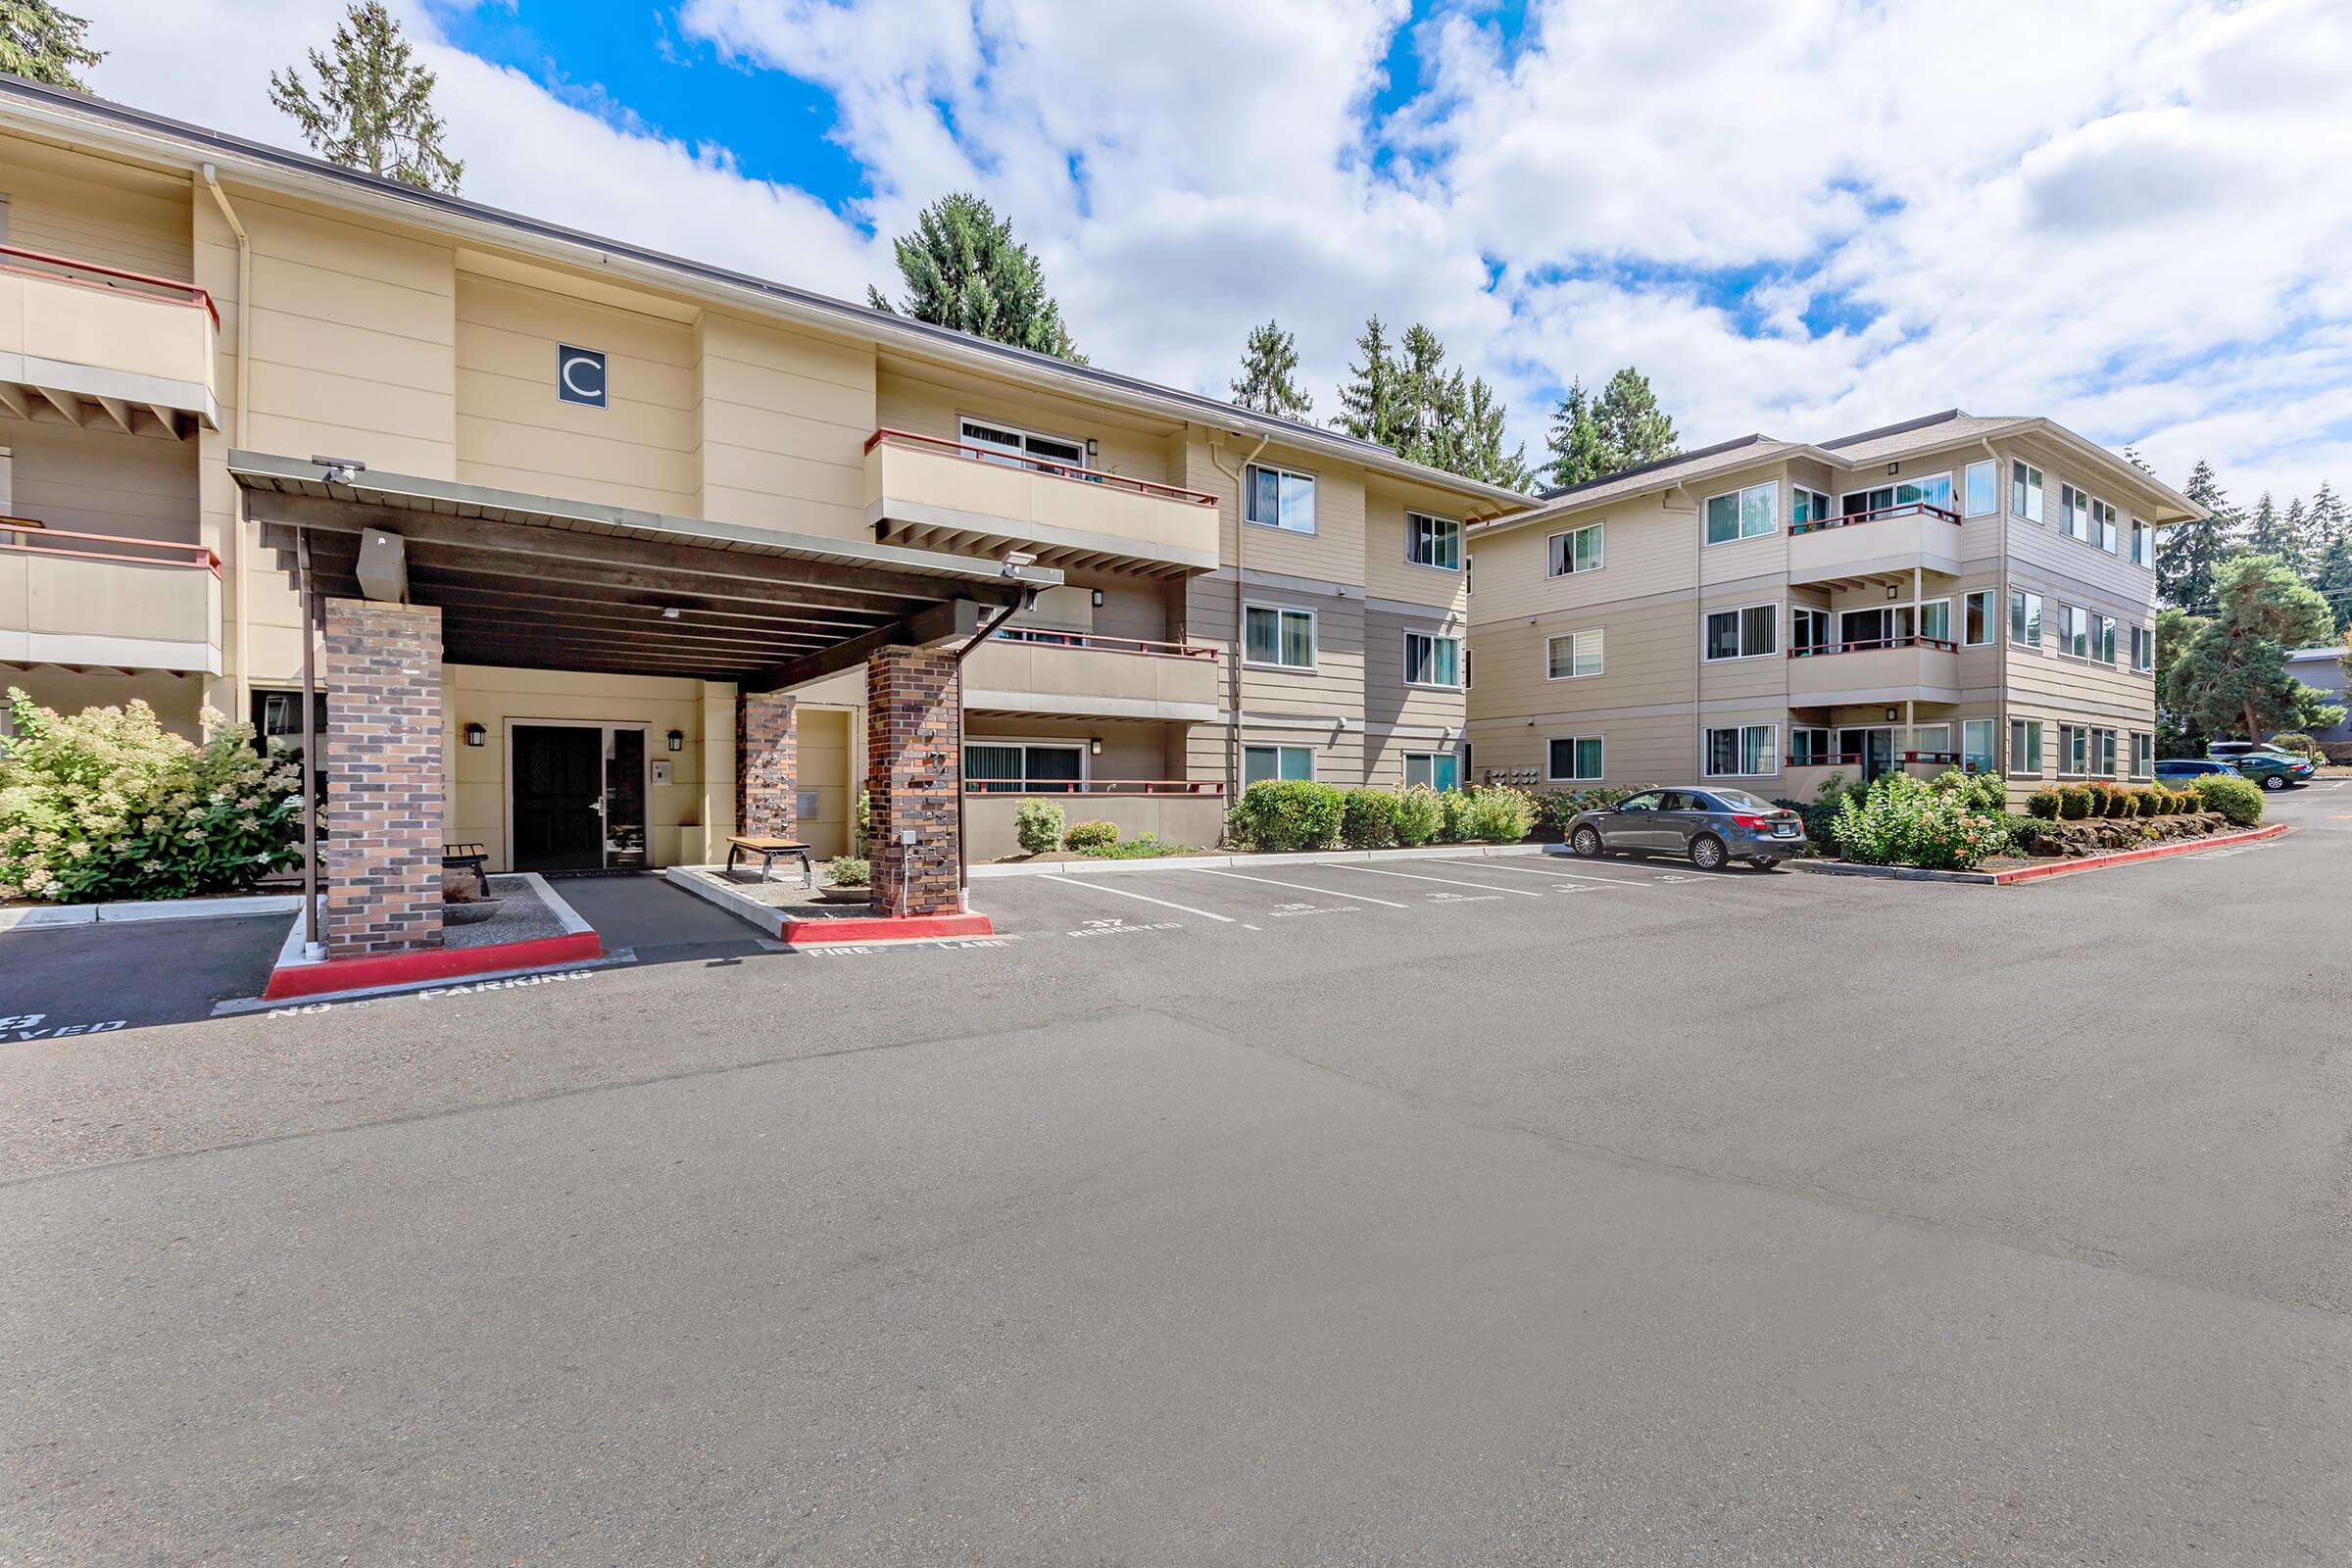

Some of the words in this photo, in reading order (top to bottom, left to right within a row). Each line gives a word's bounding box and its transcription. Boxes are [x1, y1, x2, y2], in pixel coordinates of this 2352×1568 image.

[563, 357, 602, 397] C
[1082, 918, 1123, 927] 37
[807, 945, 873, 957] FIRE
[937, 939, 1010, 950] LANE
[267, 1003, 332, 1019] NO
[418, 969, 594, 1002] PARKING
